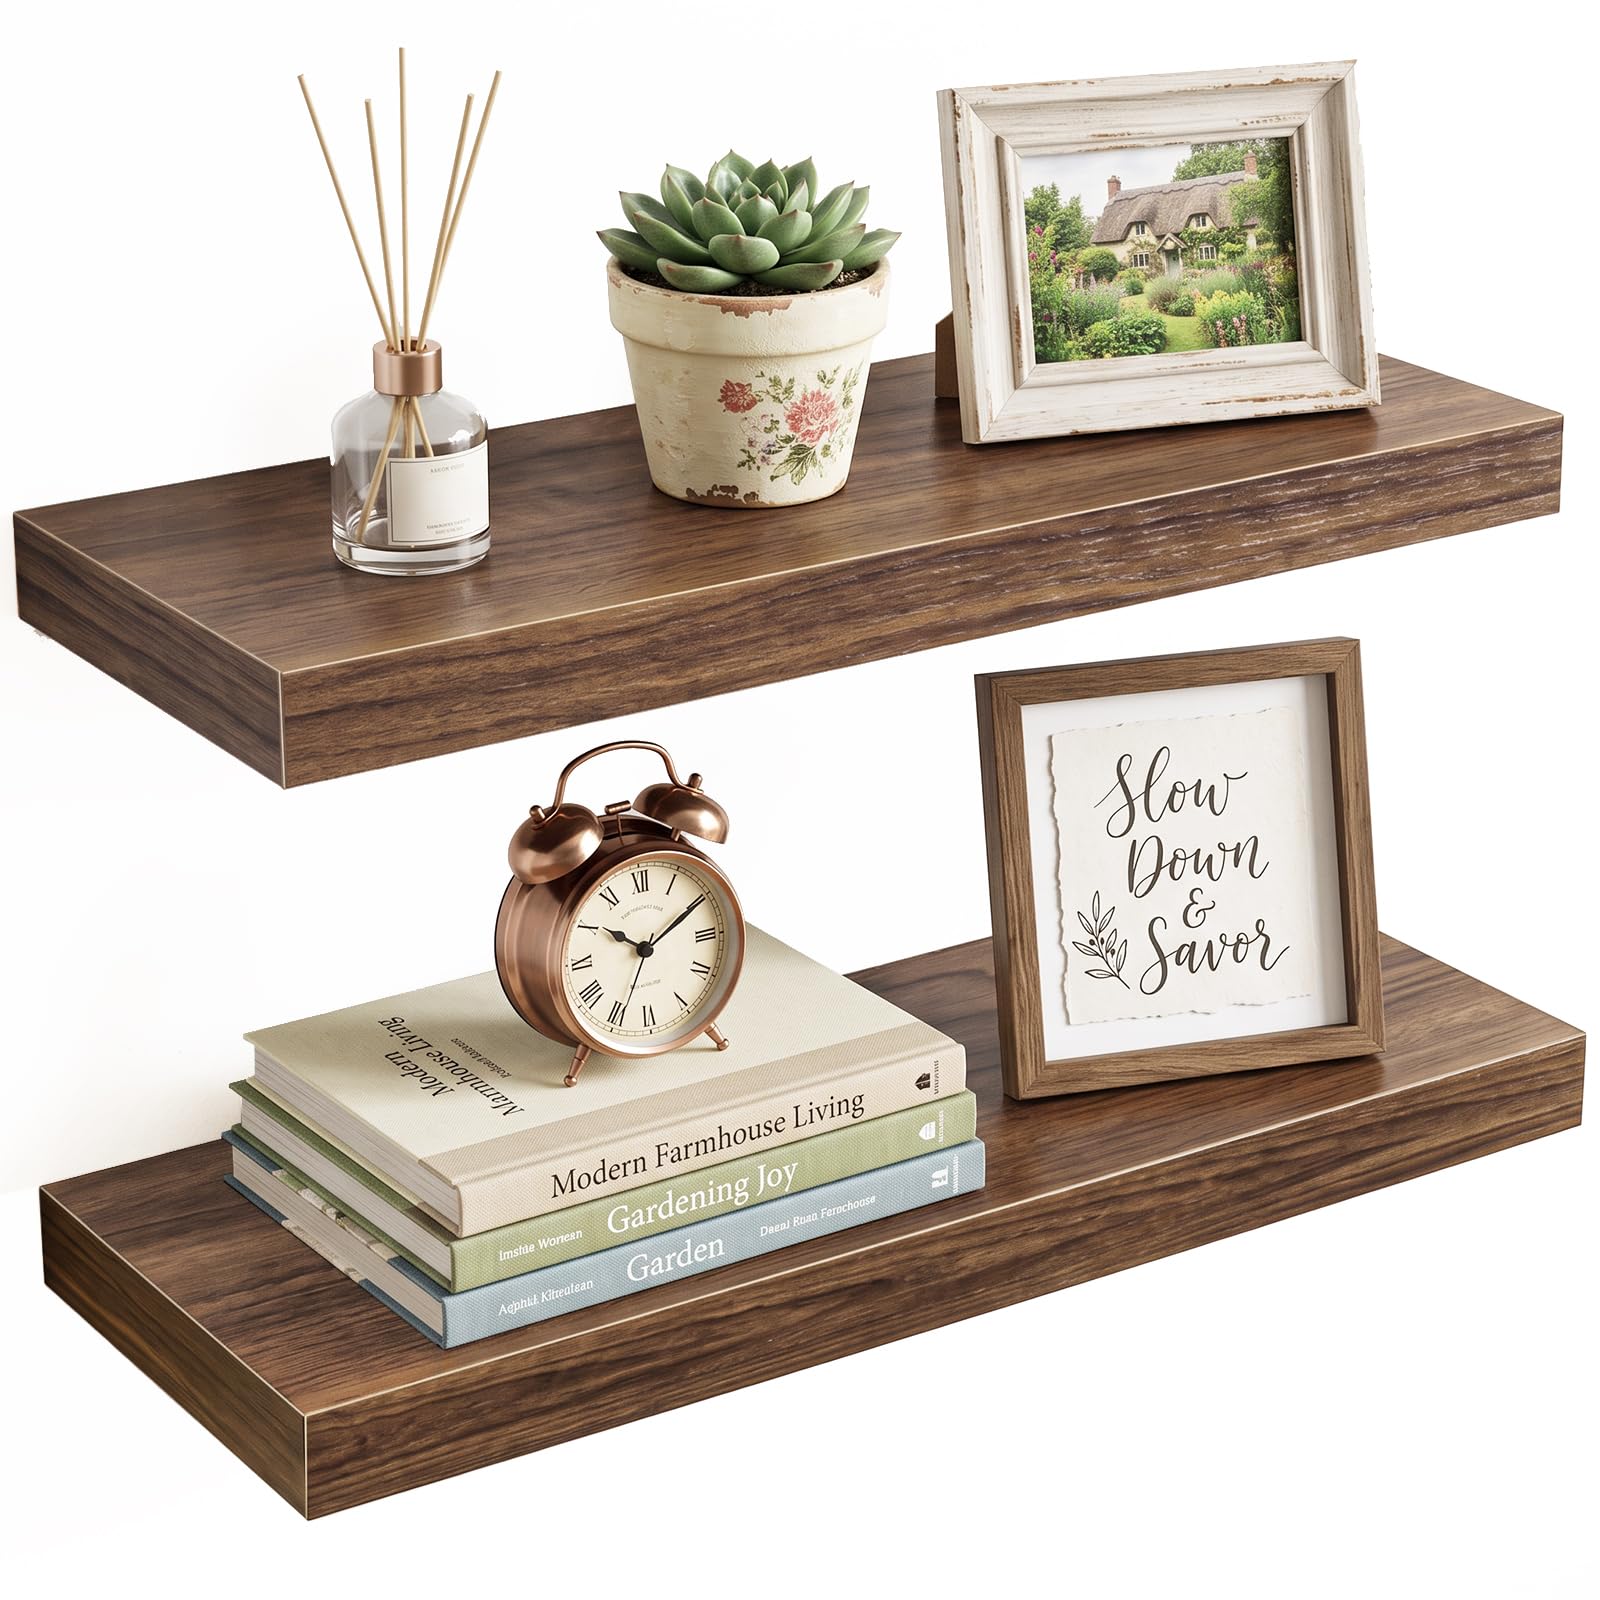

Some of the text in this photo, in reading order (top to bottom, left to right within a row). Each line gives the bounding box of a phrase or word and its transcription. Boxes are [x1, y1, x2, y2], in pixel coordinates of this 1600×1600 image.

[1094, 746, 1248, 838] Slow
[631, 869, 649, 895] XII
[1128, 836, 1269, 898] Down
[599, 886, 620, 911] XI
[1183, 888, 1215, 928] &
[577, 920, 599, 935] X
[695, 928, 716, 943] III
[1140, 917, 1290, 995] Savor
[378, 1016, 433, 1053] Living
[384, 1051, 455, 1097] Modern
[426, 1050, 525, 1116] Marmhouse
[551, 1094, 865, 1198] Modern Farmhouse Living
[607, 1162, 798, 1234] Gardening Joy
[626, 1237, 725, 1282] Garden
